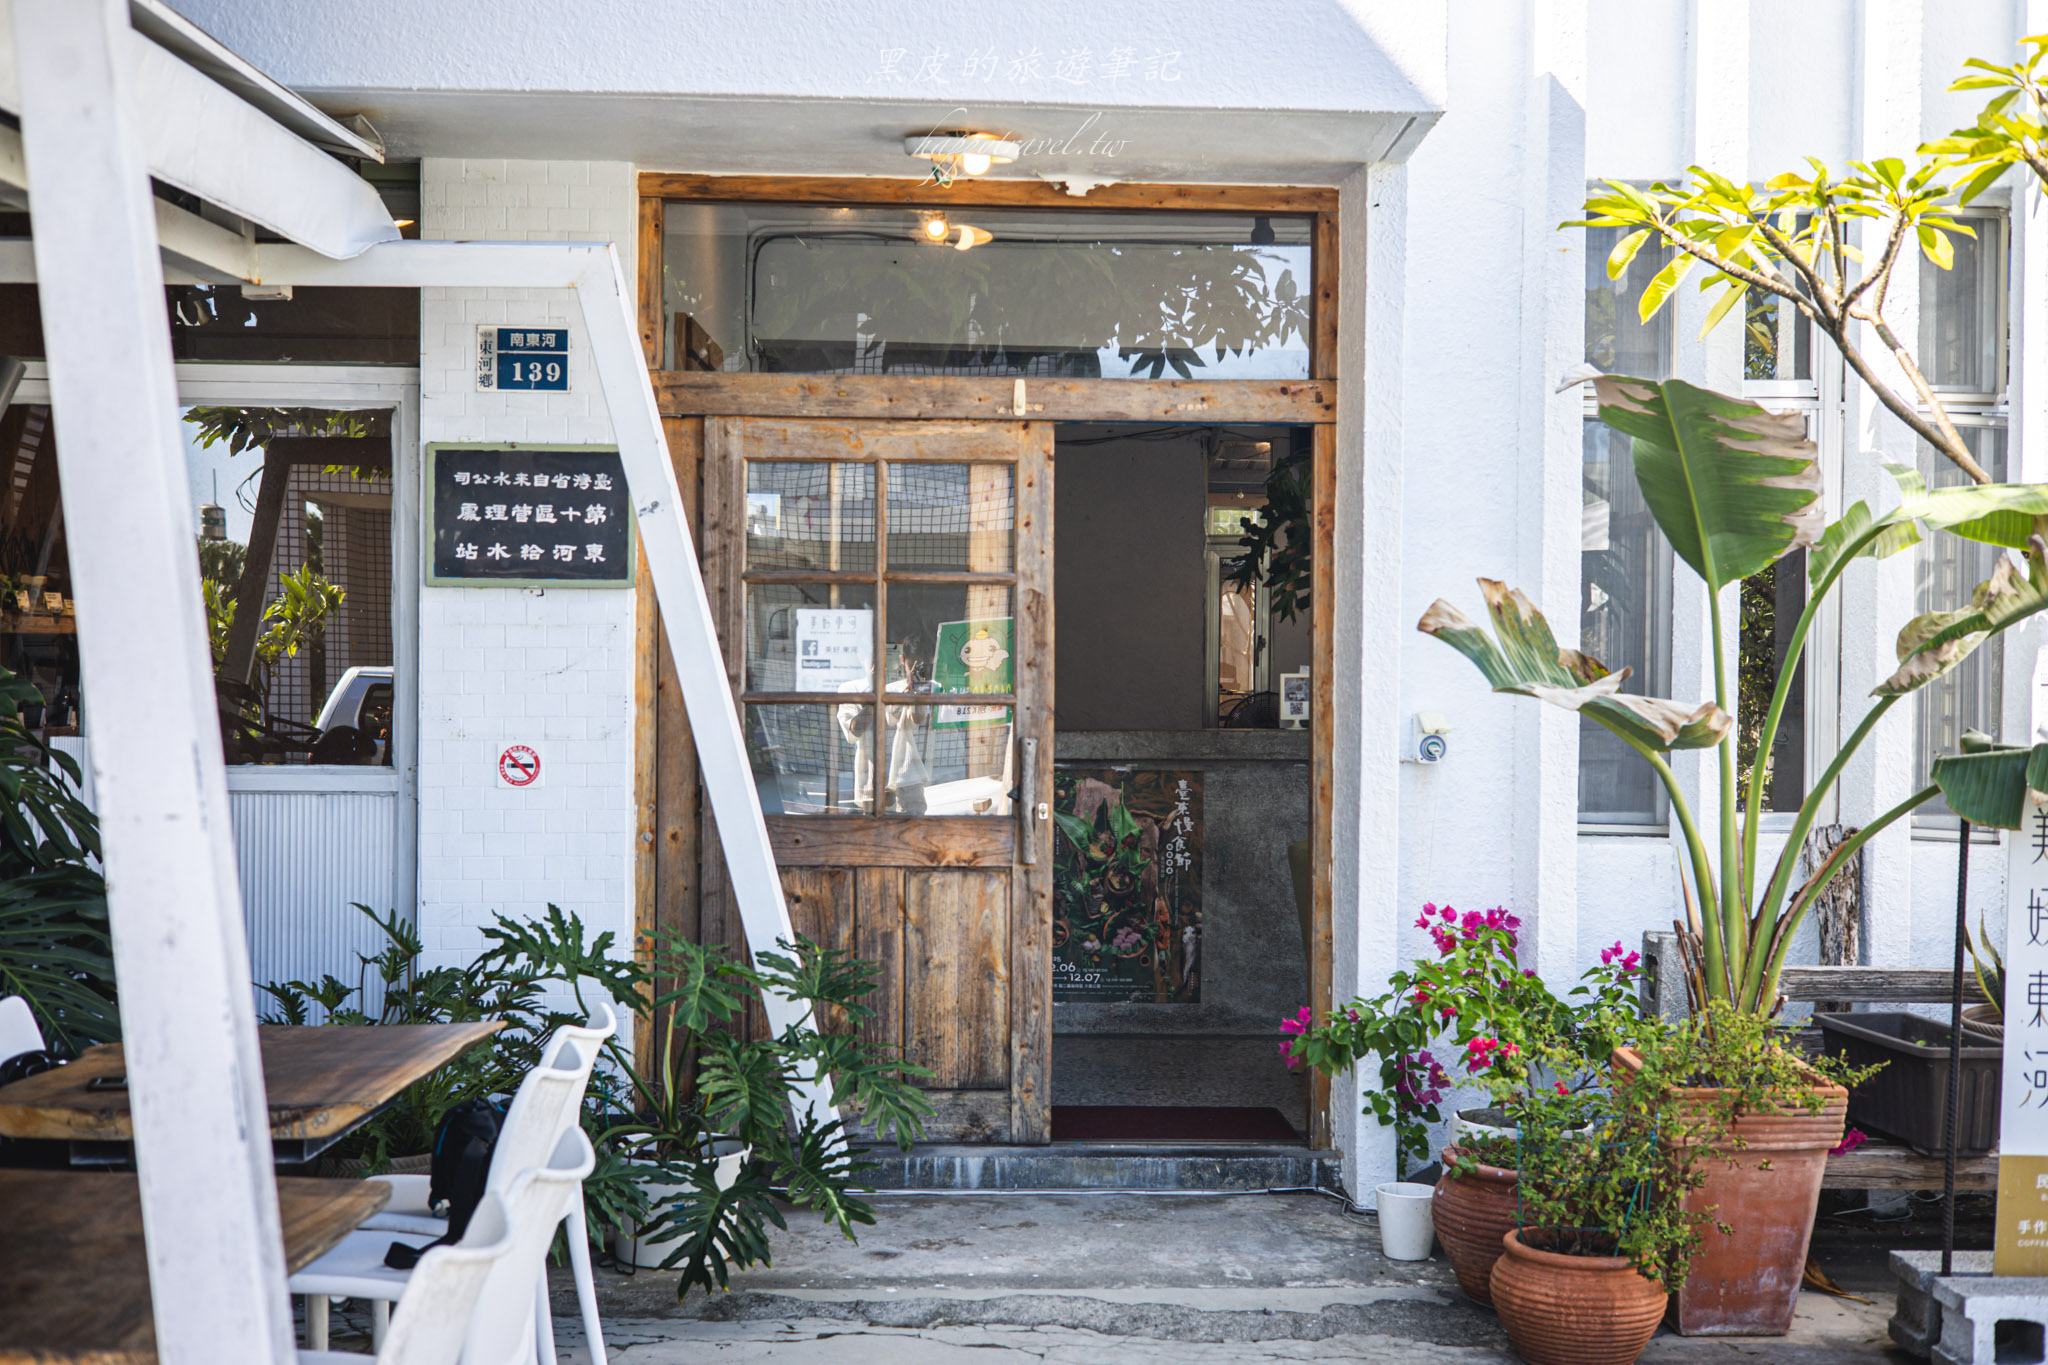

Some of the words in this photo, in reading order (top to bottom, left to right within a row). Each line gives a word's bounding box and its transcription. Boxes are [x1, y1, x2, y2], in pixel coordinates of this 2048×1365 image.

[510, 332, 557, 348] 南東河
[512, 362, 561, 382] 139
[455, 542, 607, 564] 東河給水站
[1052, 961, 1076, 972] 2.06
[1070, 973, 1101, 983] 12.07
